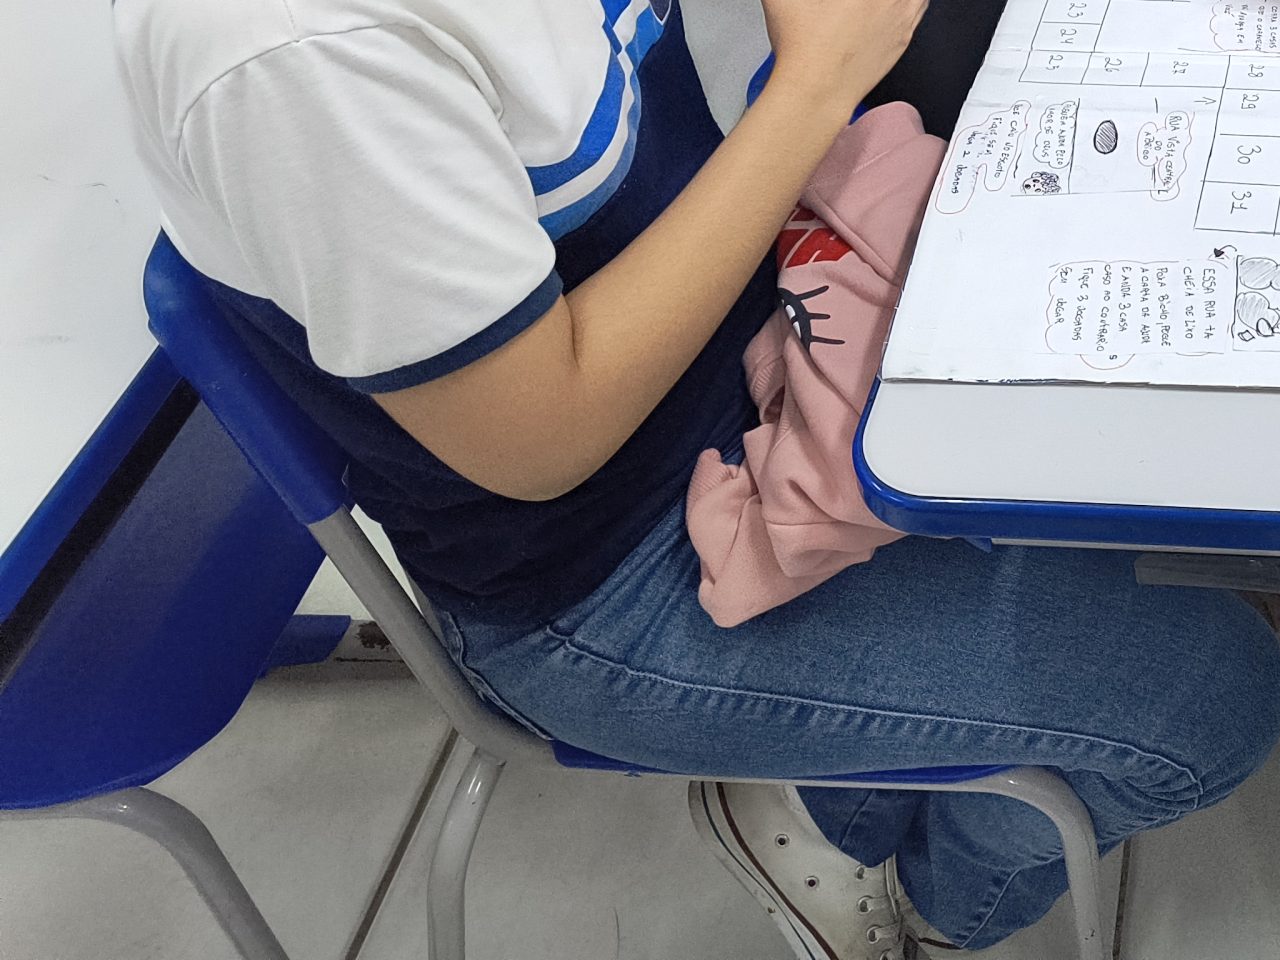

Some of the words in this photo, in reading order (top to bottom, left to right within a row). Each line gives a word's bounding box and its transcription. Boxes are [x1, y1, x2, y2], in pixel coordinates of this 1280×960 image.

[1067, 2, 1087, 19] 23
[1059, 27, 1077, 44] 24
[1046, 55, 1064, 71] 25
[1104, 58, 1123, 73] 26
[1247, 64, 1265, 78] 28
[1241, 94, 1260, 110] 29
[1169, 116, 1182, 132] RUA
[1154, 140, 1163, 151] DO
[1165, 136, 1181, 157] VISTA
[963, 150, 971, 158] 2
[1237, 145, 1262, 165] 30
[1230, 191, 1252, 214] 31
[1060, 266, 1073, 284] SEM
[1103, 264, 1112, 285] CASO
[1201, 268, 1216, 294] ESSA
[1077, 294, 1089, 302] 3
[1103, 290, 1111, 302] AO
[1054, 297, 1067, 324] JOGAR
[1118, 302, 1132, 310] 3
[1141, 307, 1151, 318] DA
[1185, 305, 1194, 317] DE
[1204, 300, 1216, 318] RUA
[1072, 305, 1086, 341] JOGADAS
